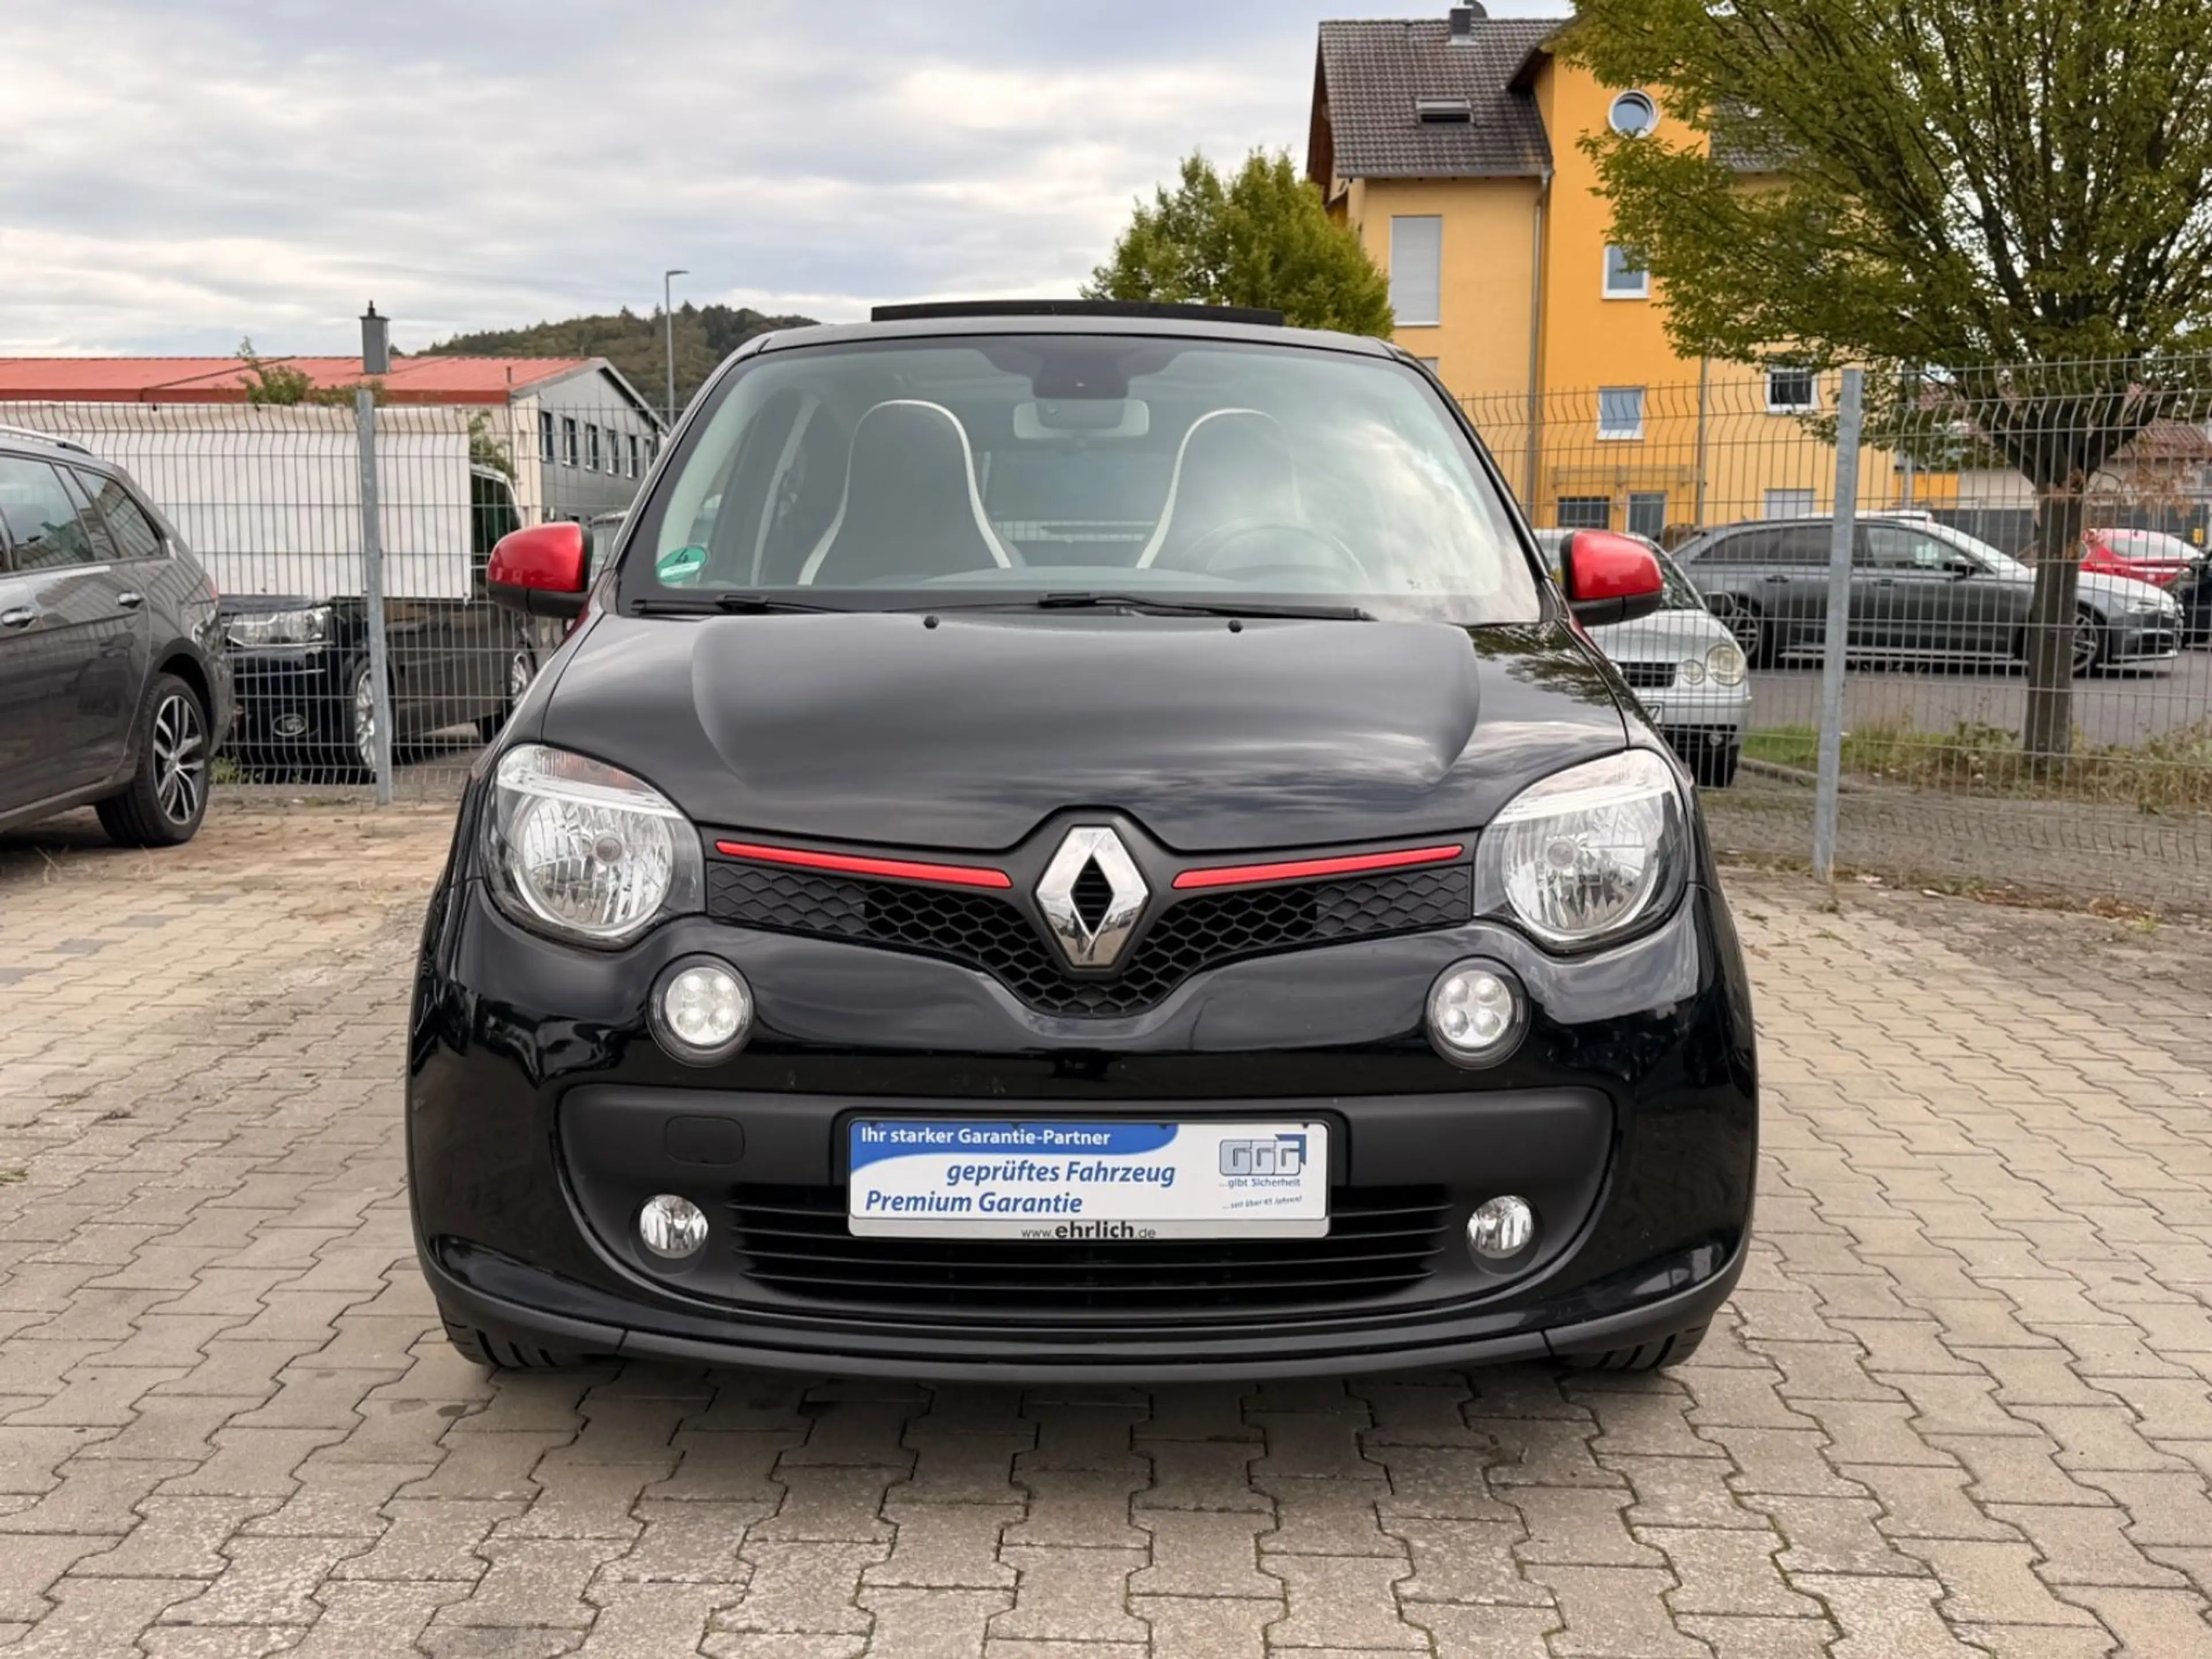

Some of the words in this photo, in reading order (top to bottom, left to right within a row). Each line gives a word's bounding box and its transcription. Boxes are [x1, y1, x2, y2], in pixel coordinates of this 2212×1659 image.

[862, 1127, 887, 1142] Ihr
[890, 1127, 955, 1143] starker
[957, 1128, 1111, 1145] Garantie-Partner
[946, 1160, 1060, 1187] geprüftes
[1066, 1161, 1176, 1187] Fahrzeug
[1251, 1177, 1301, 1187] Sicherheit
[865, 1190, 972, 1212] Premium
[979, 1191, 1083, 1213] Garantie
[1021, 1221, 1157, 1238] www.ehrlich.de
